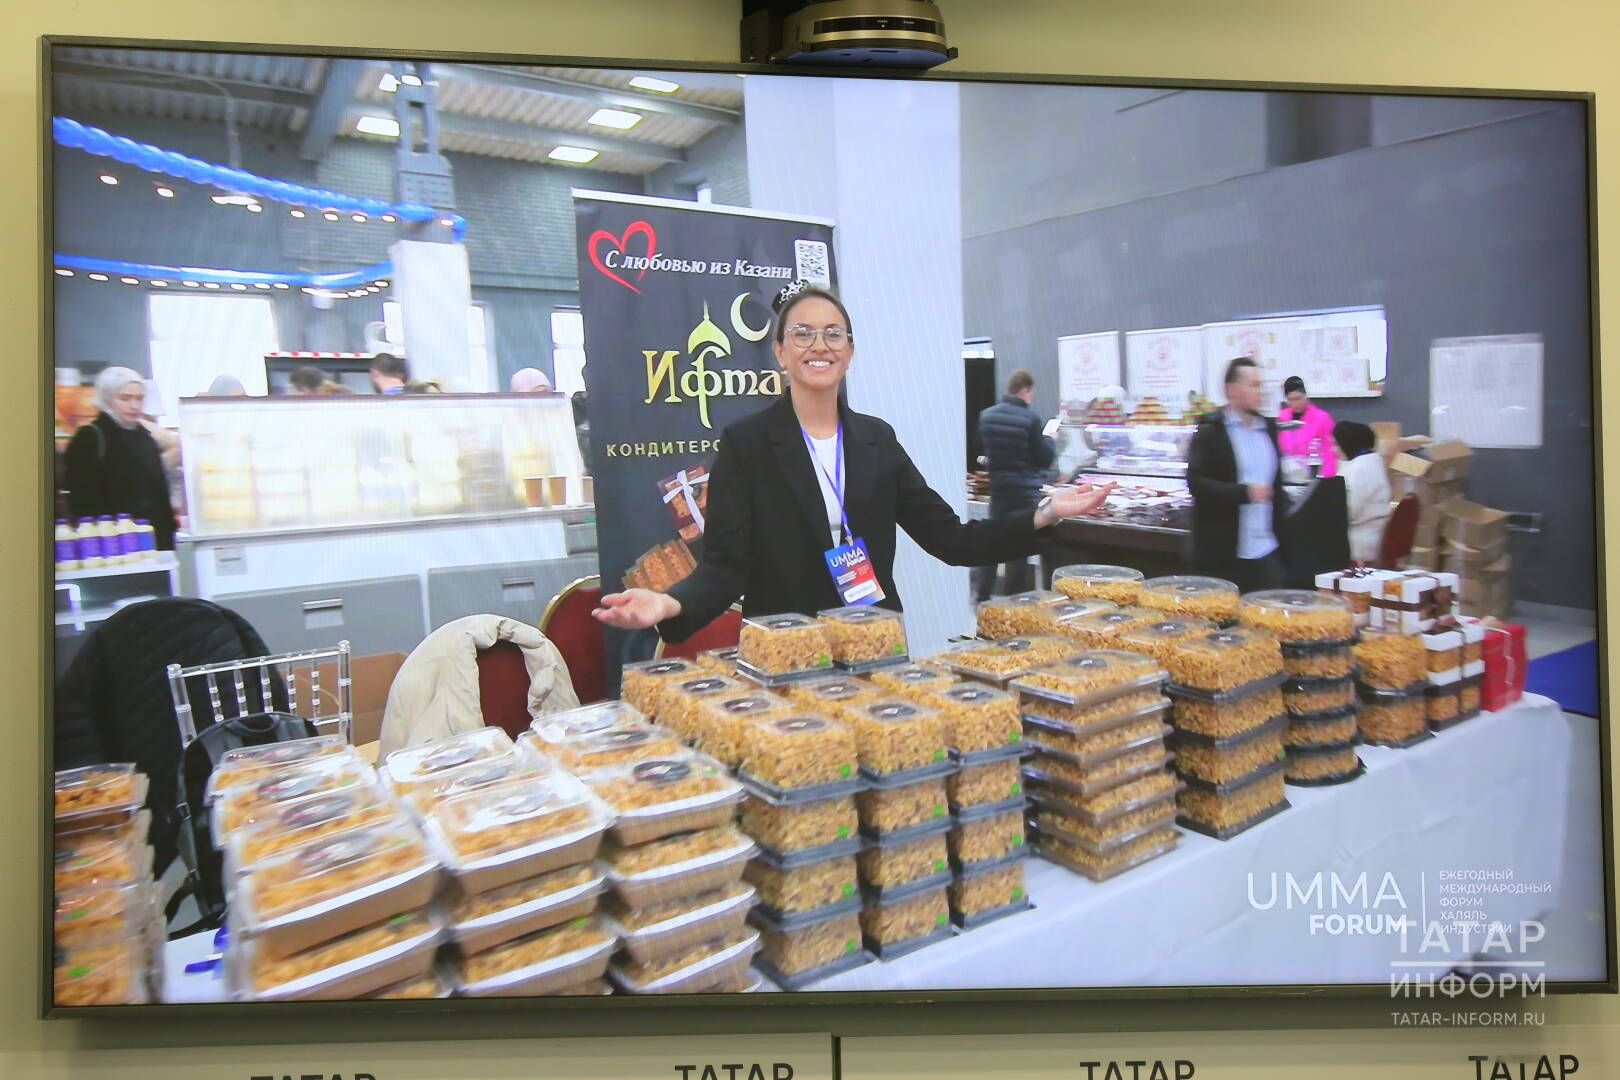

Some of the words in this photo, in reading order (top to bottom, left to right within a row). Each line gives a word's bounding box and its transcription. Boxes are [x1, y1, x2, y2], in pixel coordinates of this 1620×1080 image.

[605, 250, 619, 269] С
[621, 253, 706, 274] любовью
[709, 260, 731, 274] из
[735, 259, 792, 279] Казани
[641, 345, 787, 430] Ифта
[829, 546, 866, 568] UMMA
[1439, 869, 1514, 882] ЕЖЕГОДНЫЙ
[1247, 871, 1408, 910] UMMA
[1439, 882, 1553, 895] МЕЖДУНАРОДНЫЙ
[1439, 897, 1483, 908] ФОРУМ
[1440, 909, 1488, 921] ХАЛЯЛЬ
[1309, 914, 1408, 936] FORUM
[1440, 922, 1512, 935] ИНДУСТРИИ
